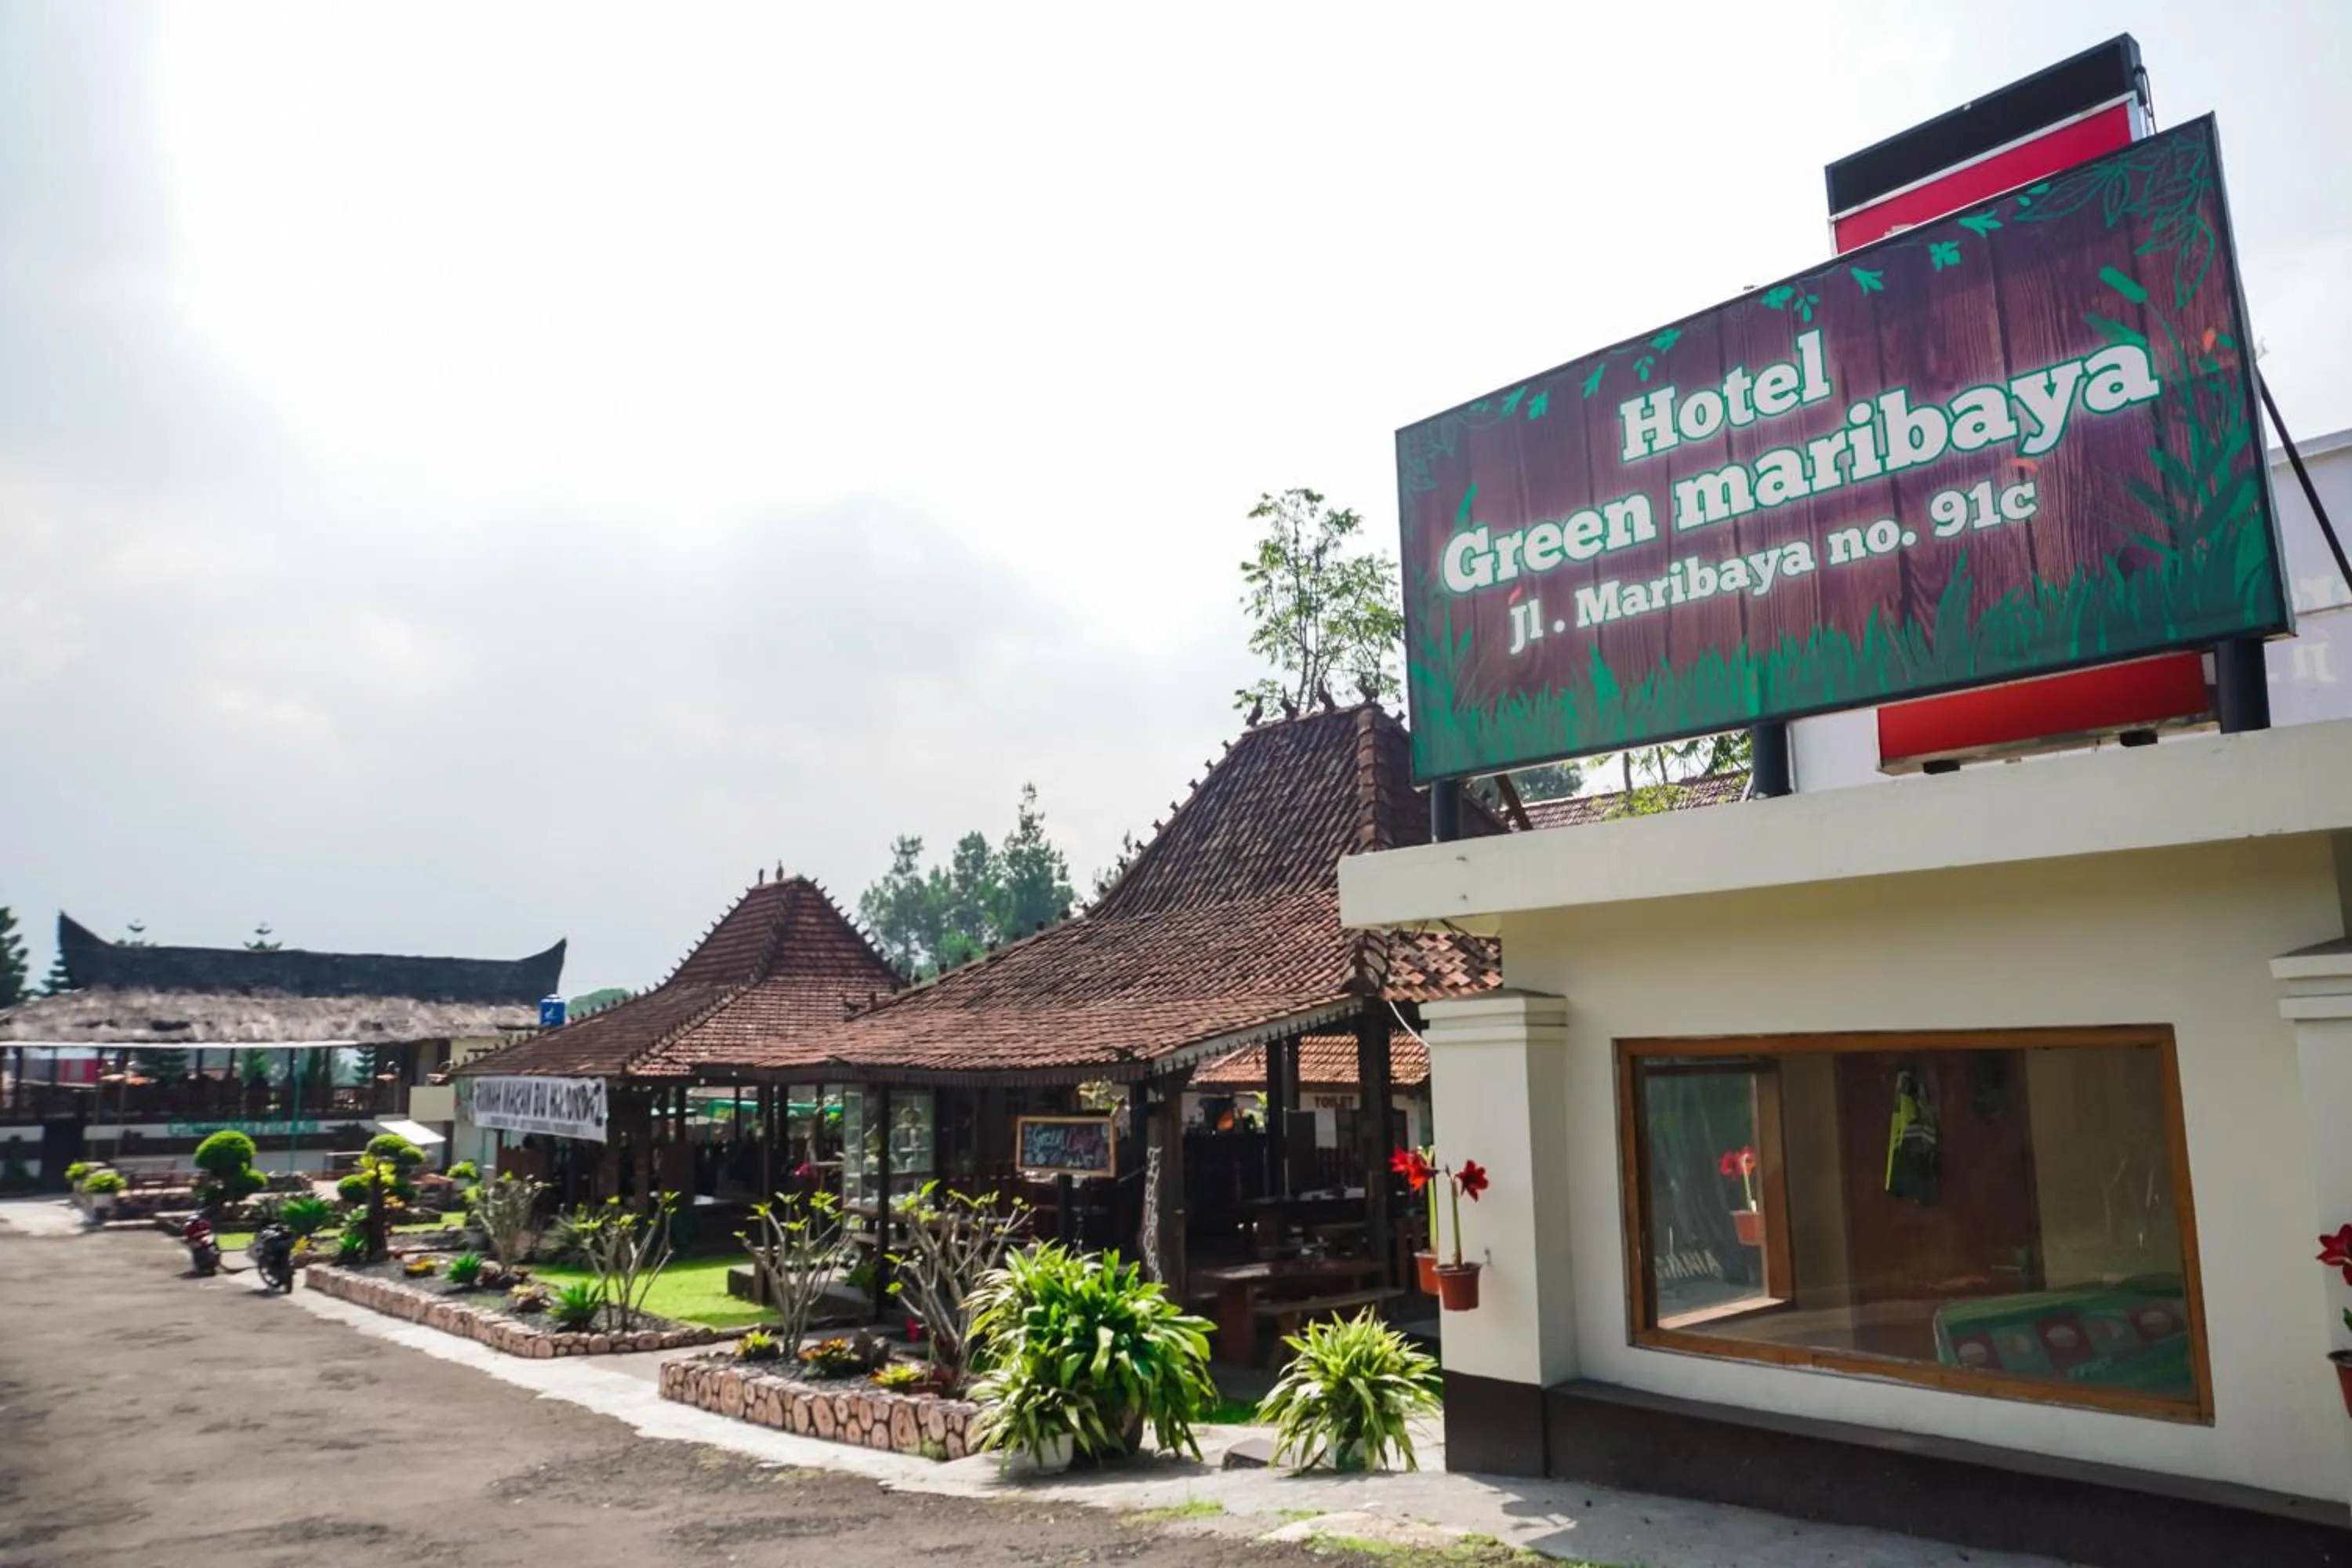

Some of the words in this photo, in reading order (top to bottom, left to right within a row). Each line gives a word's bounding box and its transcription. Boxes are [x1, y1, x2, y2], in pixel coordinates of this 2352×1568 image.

[1443, 492, 1657, 593] Green
[1675, 343, 2161, 531] maribaya
[1619, 328, 1831, 463] Hotel
[1574, 539, 1816, 628] Maribaya
[1827, 517, 1918, 565] no.
[1929, 480, 2038, 538] 91c
